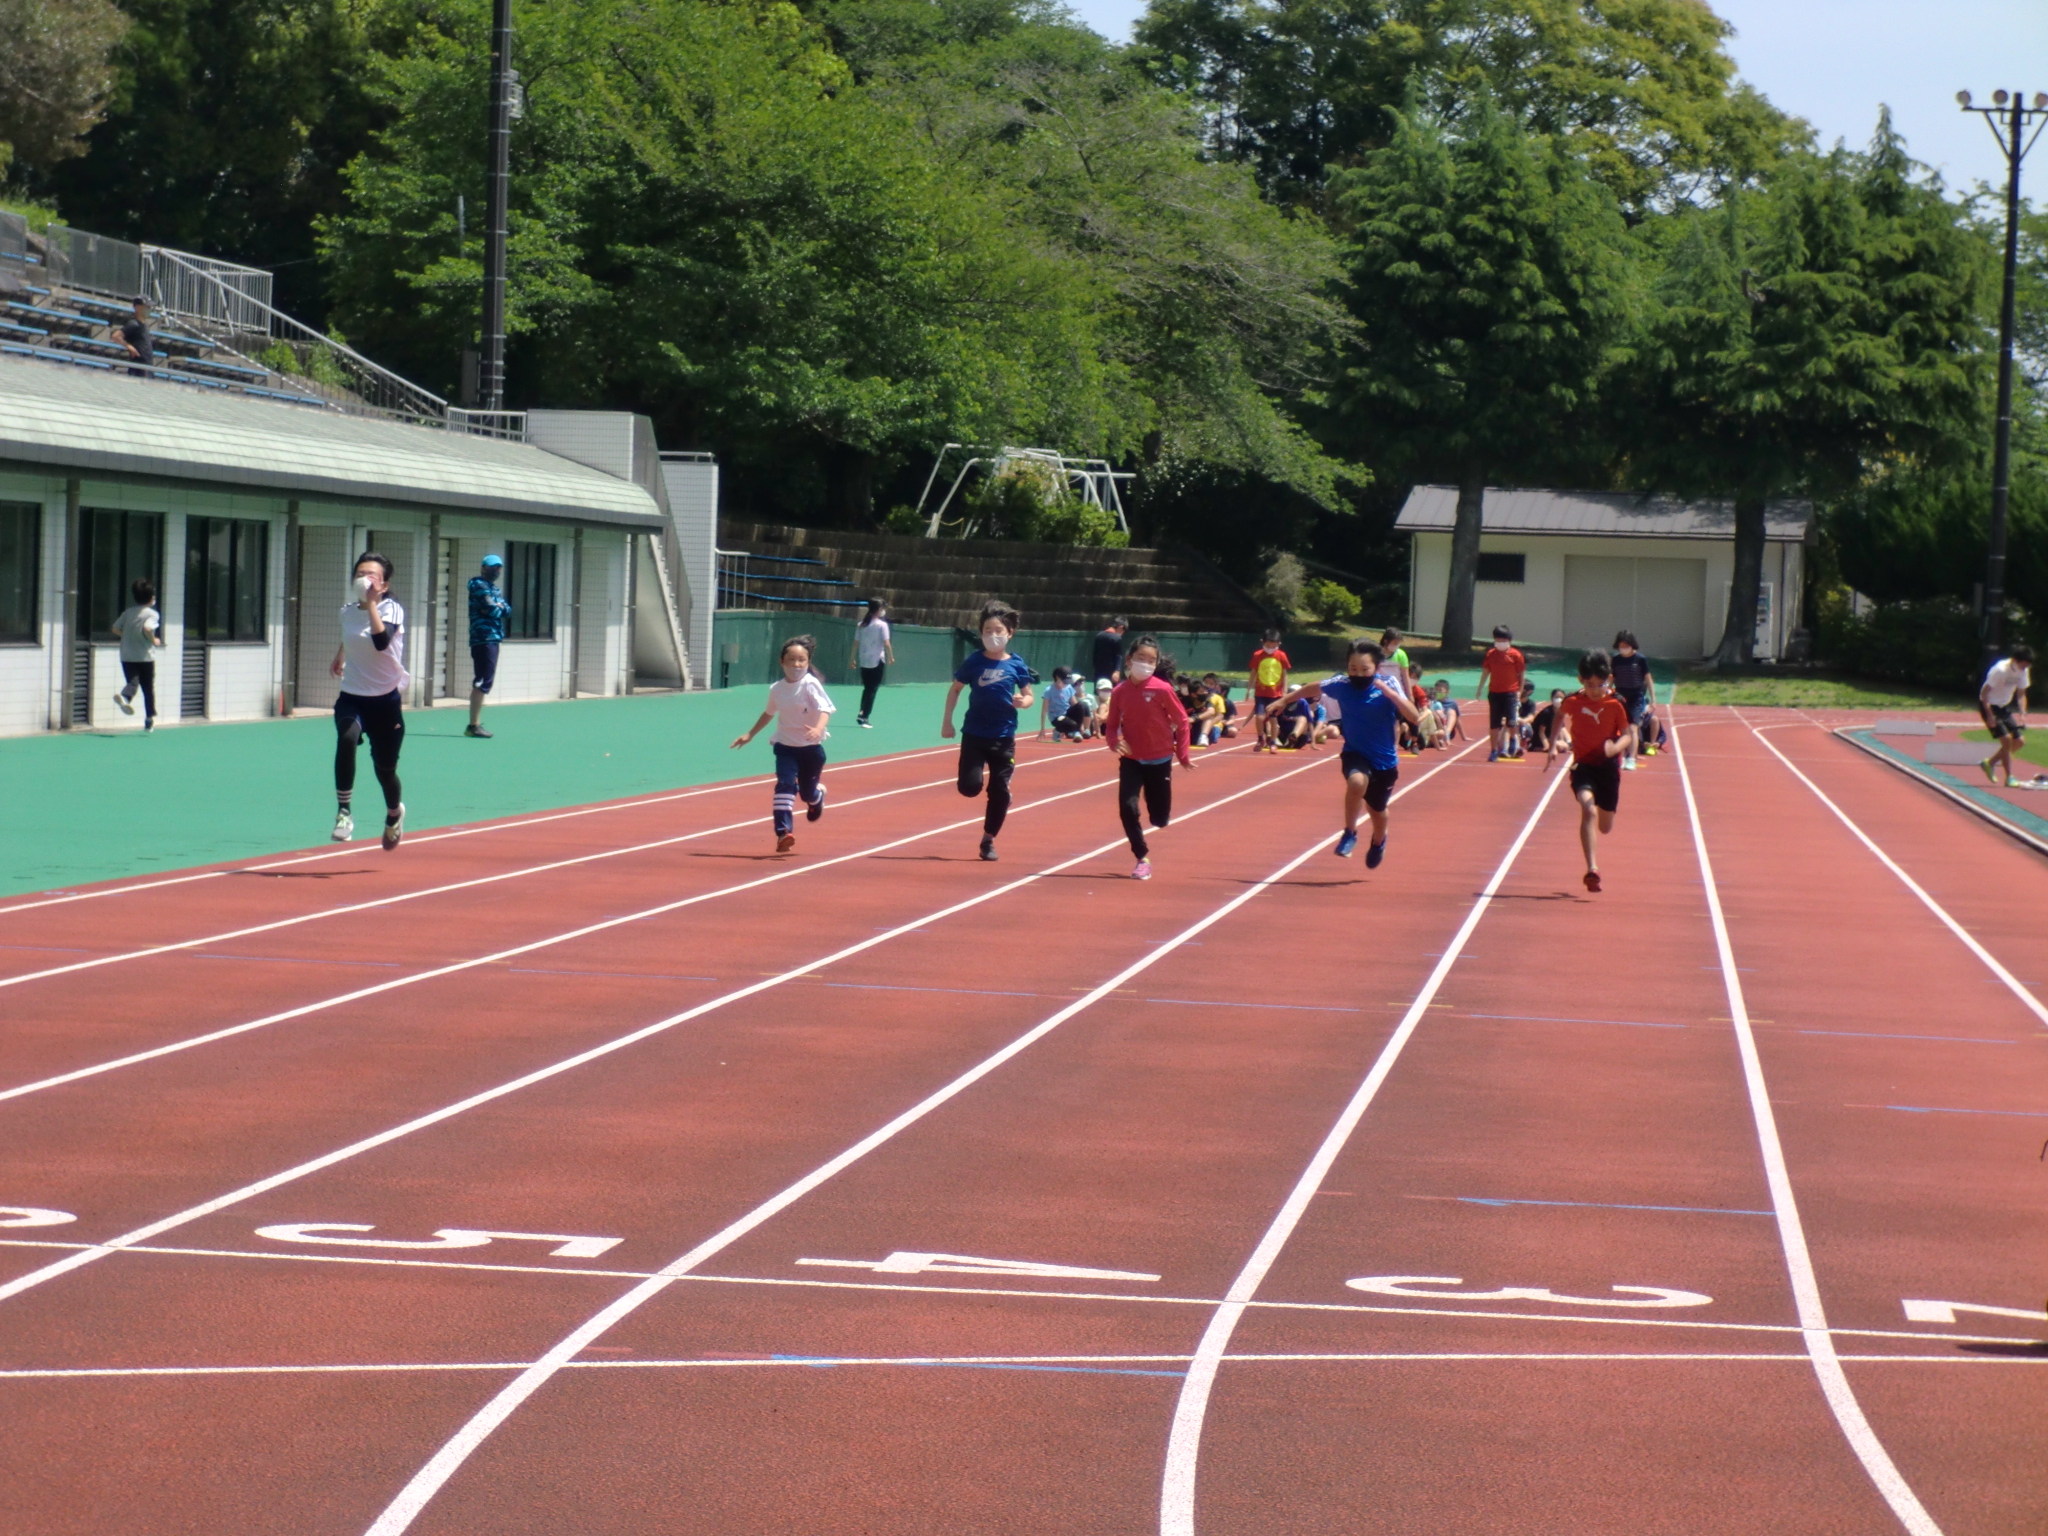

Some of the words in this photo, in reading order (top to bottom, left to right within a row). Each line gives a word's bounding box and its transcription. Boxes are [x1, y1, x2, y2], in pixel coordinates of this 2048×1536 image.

[982, 668, 1005, 679] NIKE
[254, 1222, 625, 1259] 5
[794, 1250, 1162, 1282] 4
[1345, 1275, 1713, 1308] 3
